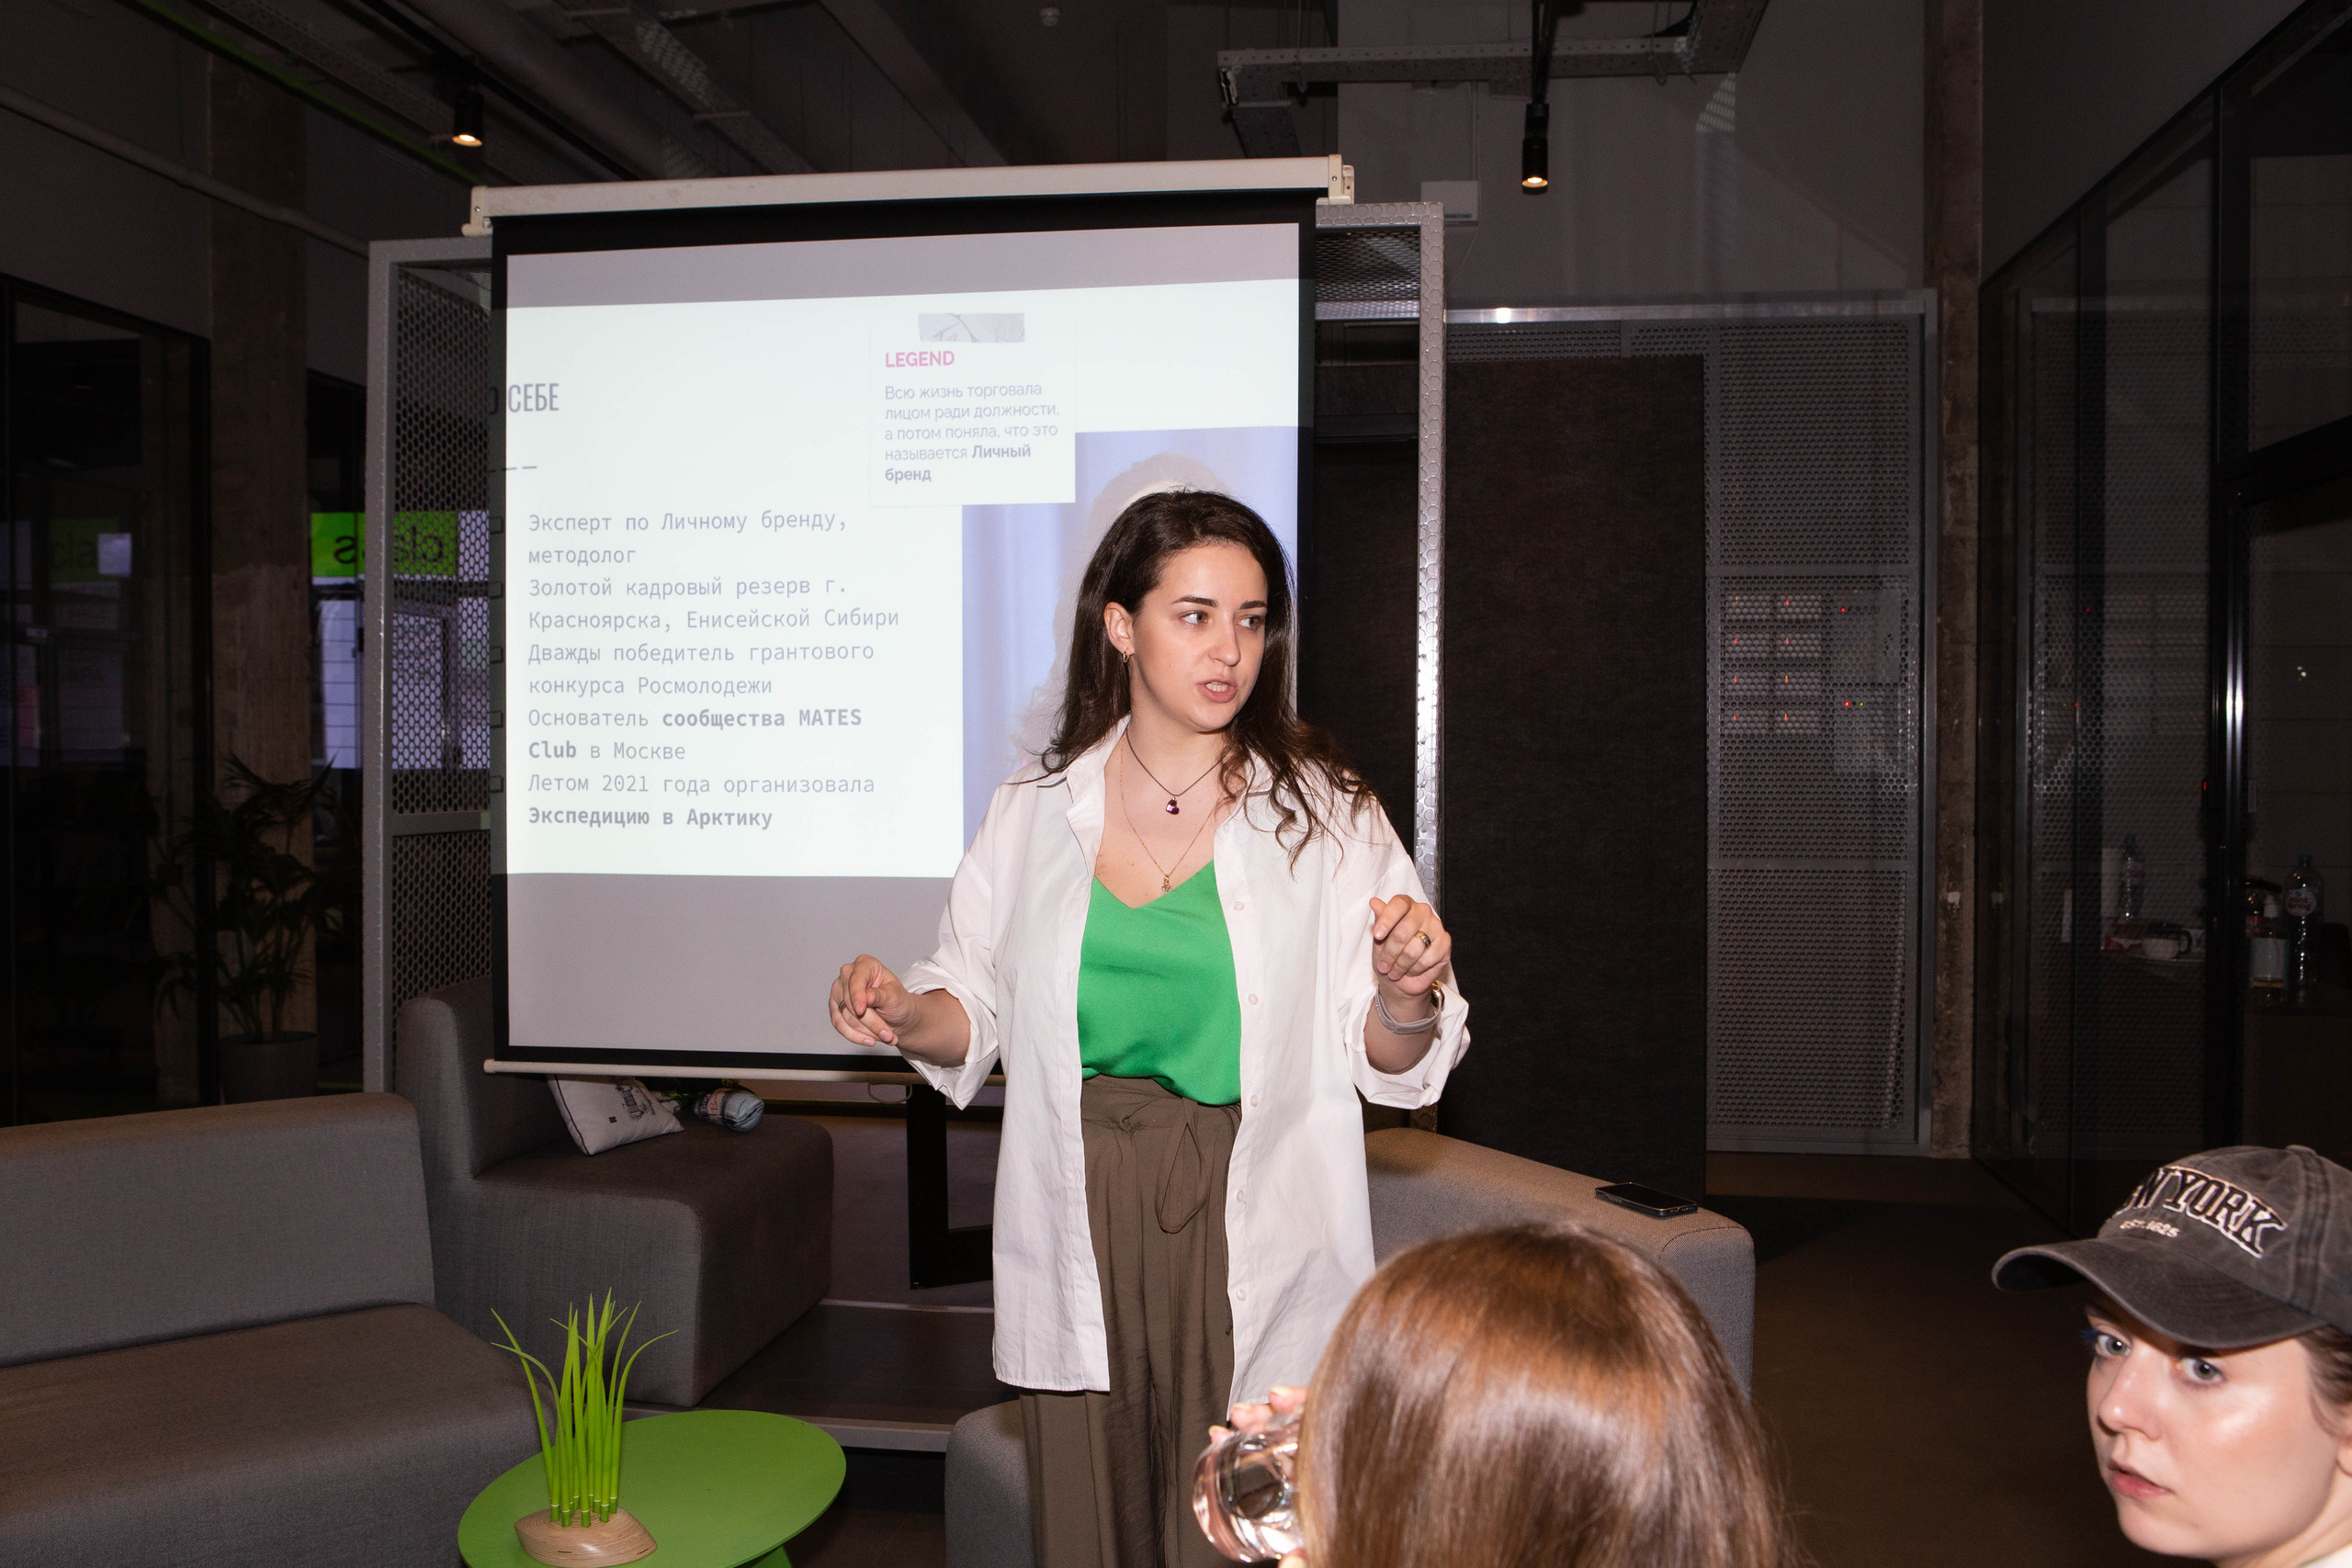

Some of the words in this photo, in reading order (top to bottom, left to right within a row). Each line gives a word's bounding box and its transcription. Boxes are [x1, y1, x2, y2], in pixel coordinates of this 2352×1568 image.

[885, 350, 956, 368] LEGEND
[508, 383, 559, 412] СЕБЕ
[885, 385, 916, 400] Всю
[919, 386, 963, 399] жизнь
[966, 384, 1043, 400] торговала
[885, 408, 931, 422] лицом
[934, 406, 970, 423] ради
[884, 429, 894, 442] а
[897, 428, 942, 441] потом
[1003, 425, 1029, 437] что
[1032, 424, 1058, 437] это
[885, 447, 968, 461] называется
[971, 443, 1032, 459] Личный
[884, 467, 933, 485] бренд
[528, 513, 613, 536] Эксперт
[626, 516, 650, 531] по
[661, 513, 748, 535] Личному
[761, 509, 845, 534] бренду,
[528, 549, 637, 567] методолог
[528, 577, 612, 597] Золотой
[626, 576, 722, 601] кадровый
[736, 580, 811, 600] резерв
[825, 579, 845, 593] г.
[529, 611, 671, 634] Красноярска,
[686, 607, 809, 628] Енисейской
[824, 606, 899, 631] Сибири
[527, 643, 601, 666] Дважды
[614, 642, 734, 665] победитель
[750, 645, 875, 666] грантового
[529, 678, 625, 697] конкурса
[638, 676, 772, 698] Росмолодежи
[528, 708, 649, 727] Основатель
[662, 707, 786, 731] сообщества
[798, 708, 862, 727] MATES
[528, 739, 577, 759] Club
[590, 745, 601, 759] в
[613, 741, 685, 760] Москве
[527, 773, 589, 792] Летом
[602, 773, 649, 793] 2021
[663, 778, 710, 797] года
[723, 778, 875, 798] организовала
[528, 807, 650, 829] Экспедицию
[662, 811, 673, 826] в
[685, 807, 773, 831] Арктику
[2163, 1167, 2288, 1258] YORK
